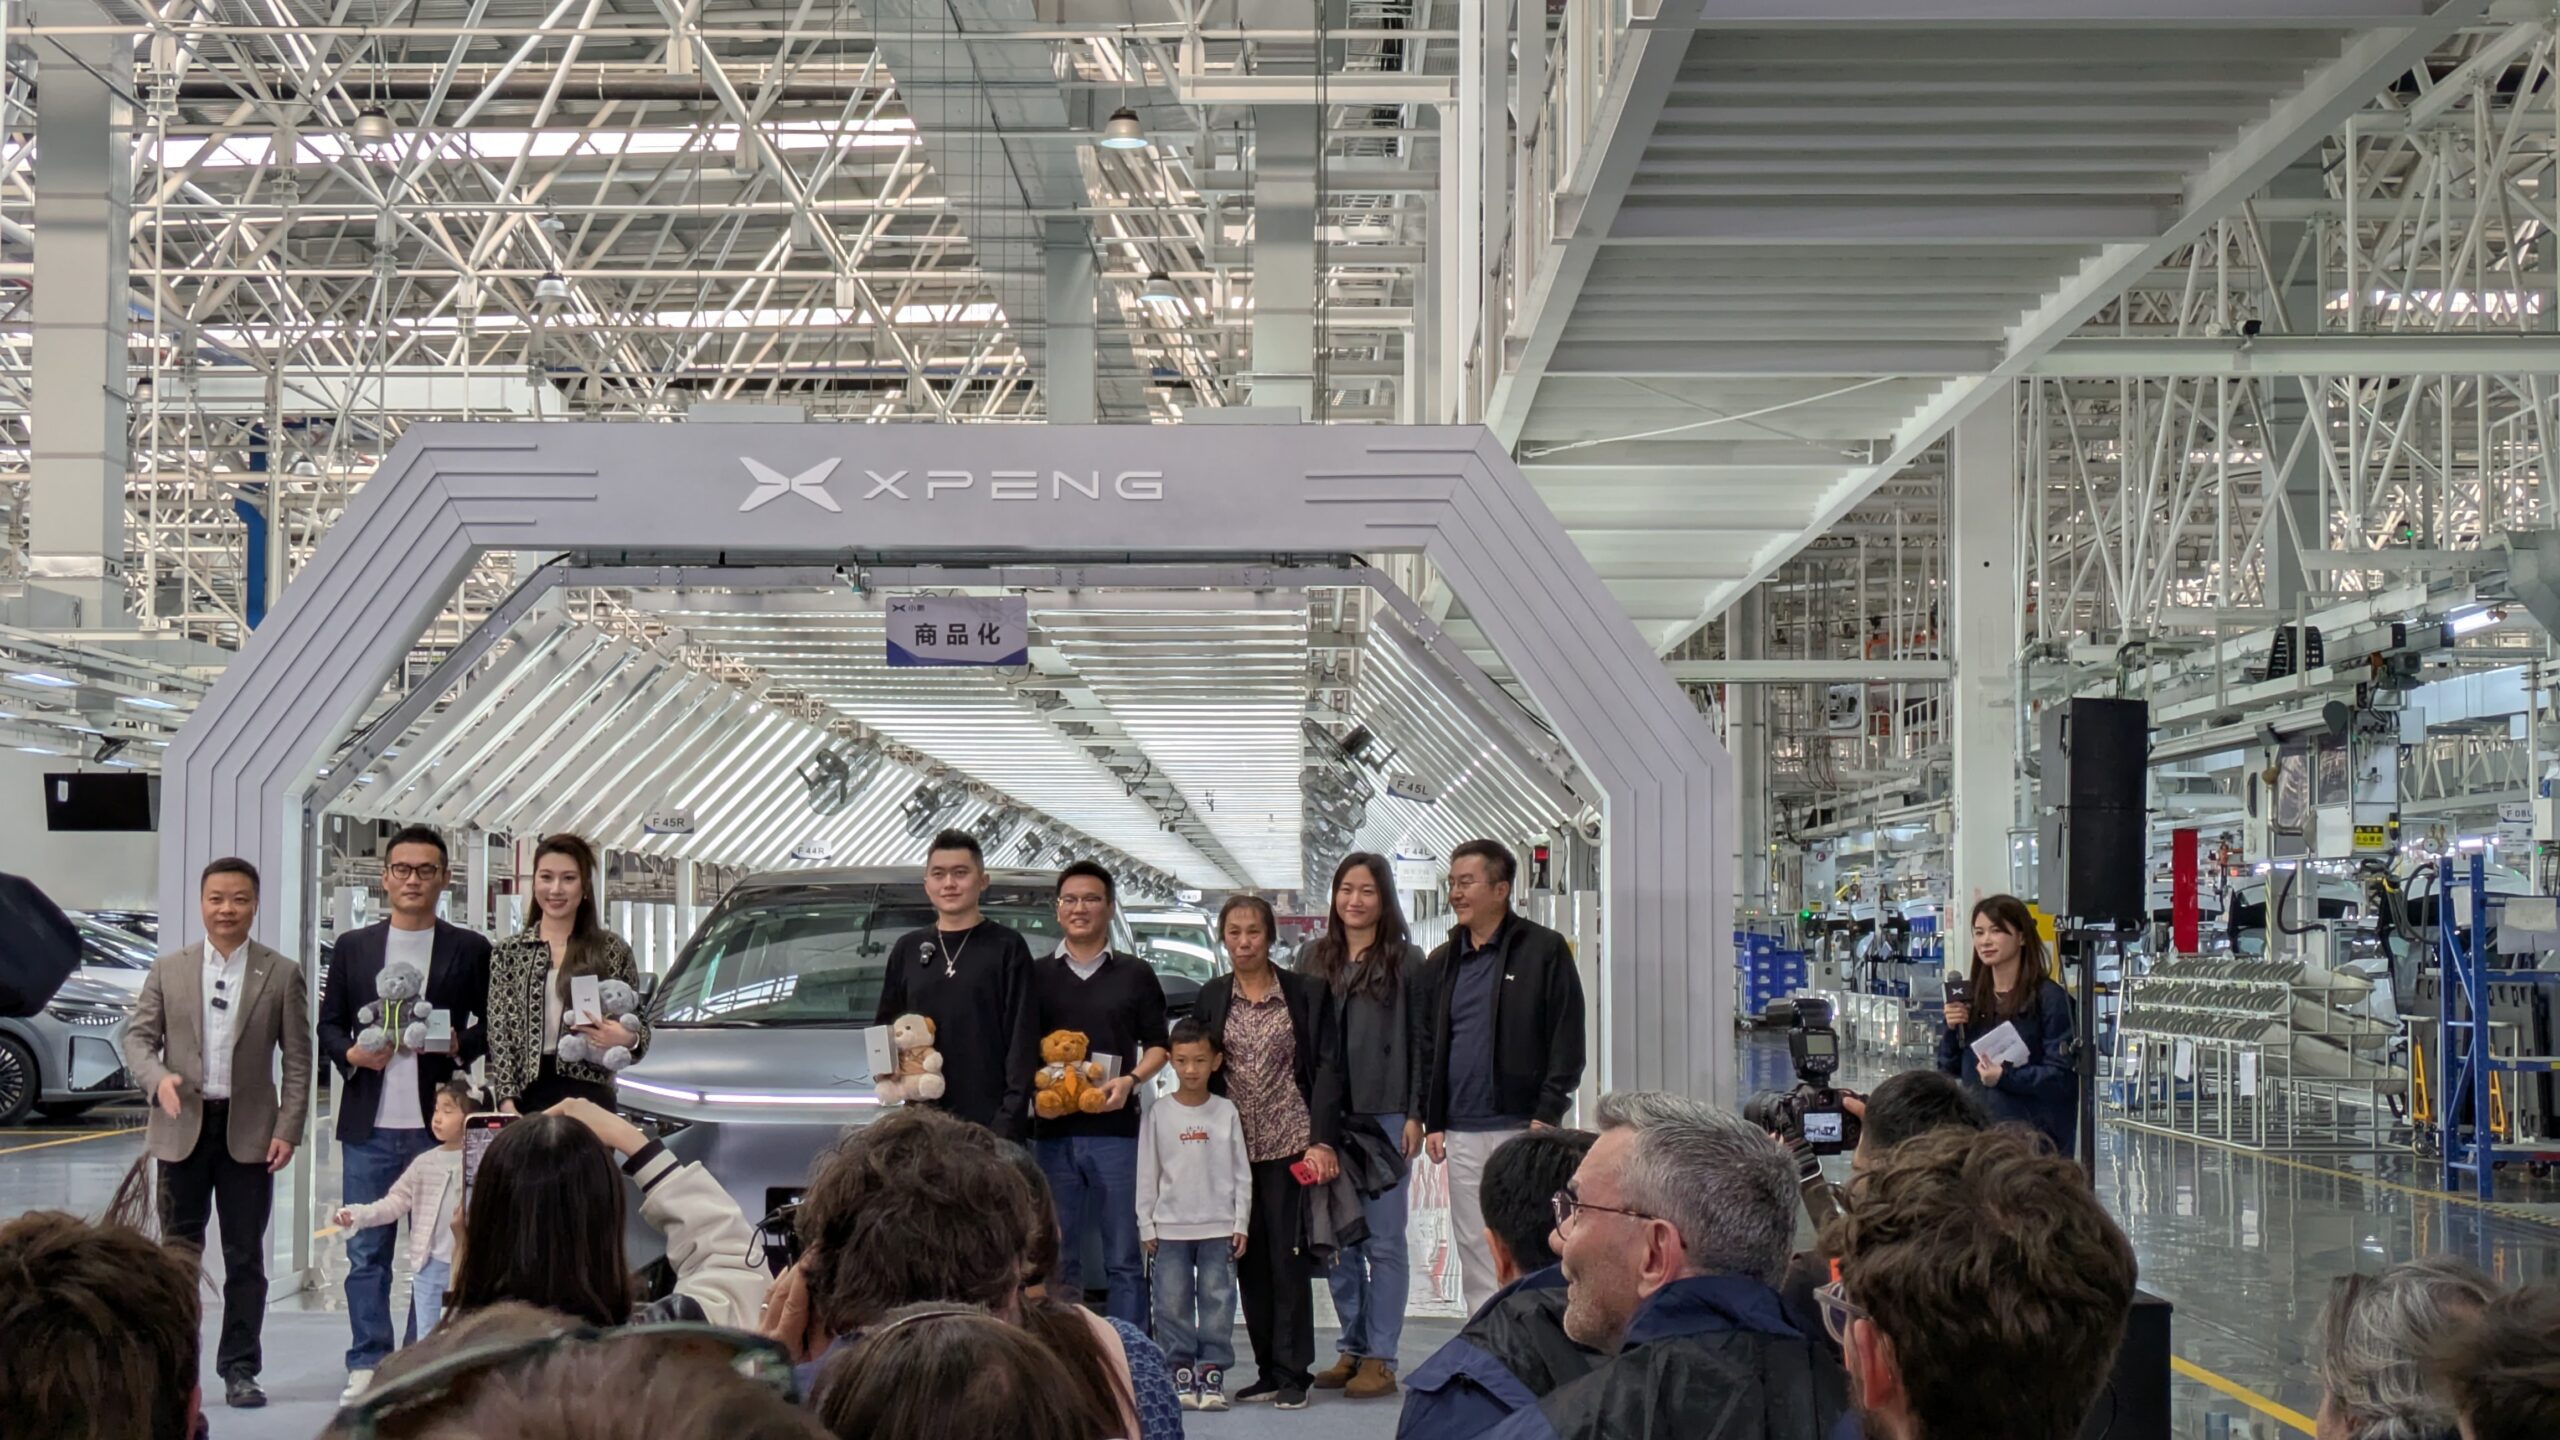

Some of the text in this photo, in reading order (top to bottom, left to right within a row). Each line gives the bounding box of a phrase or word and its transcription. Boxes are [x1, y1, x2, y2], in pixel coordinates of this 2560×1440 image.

[863, 470, 1163, 500] XPENG
[914, 622, 1001, 646] 商品化
[1396, 780, 1429, 796] F 45L
[653, 817, 685, 828] F 45R
